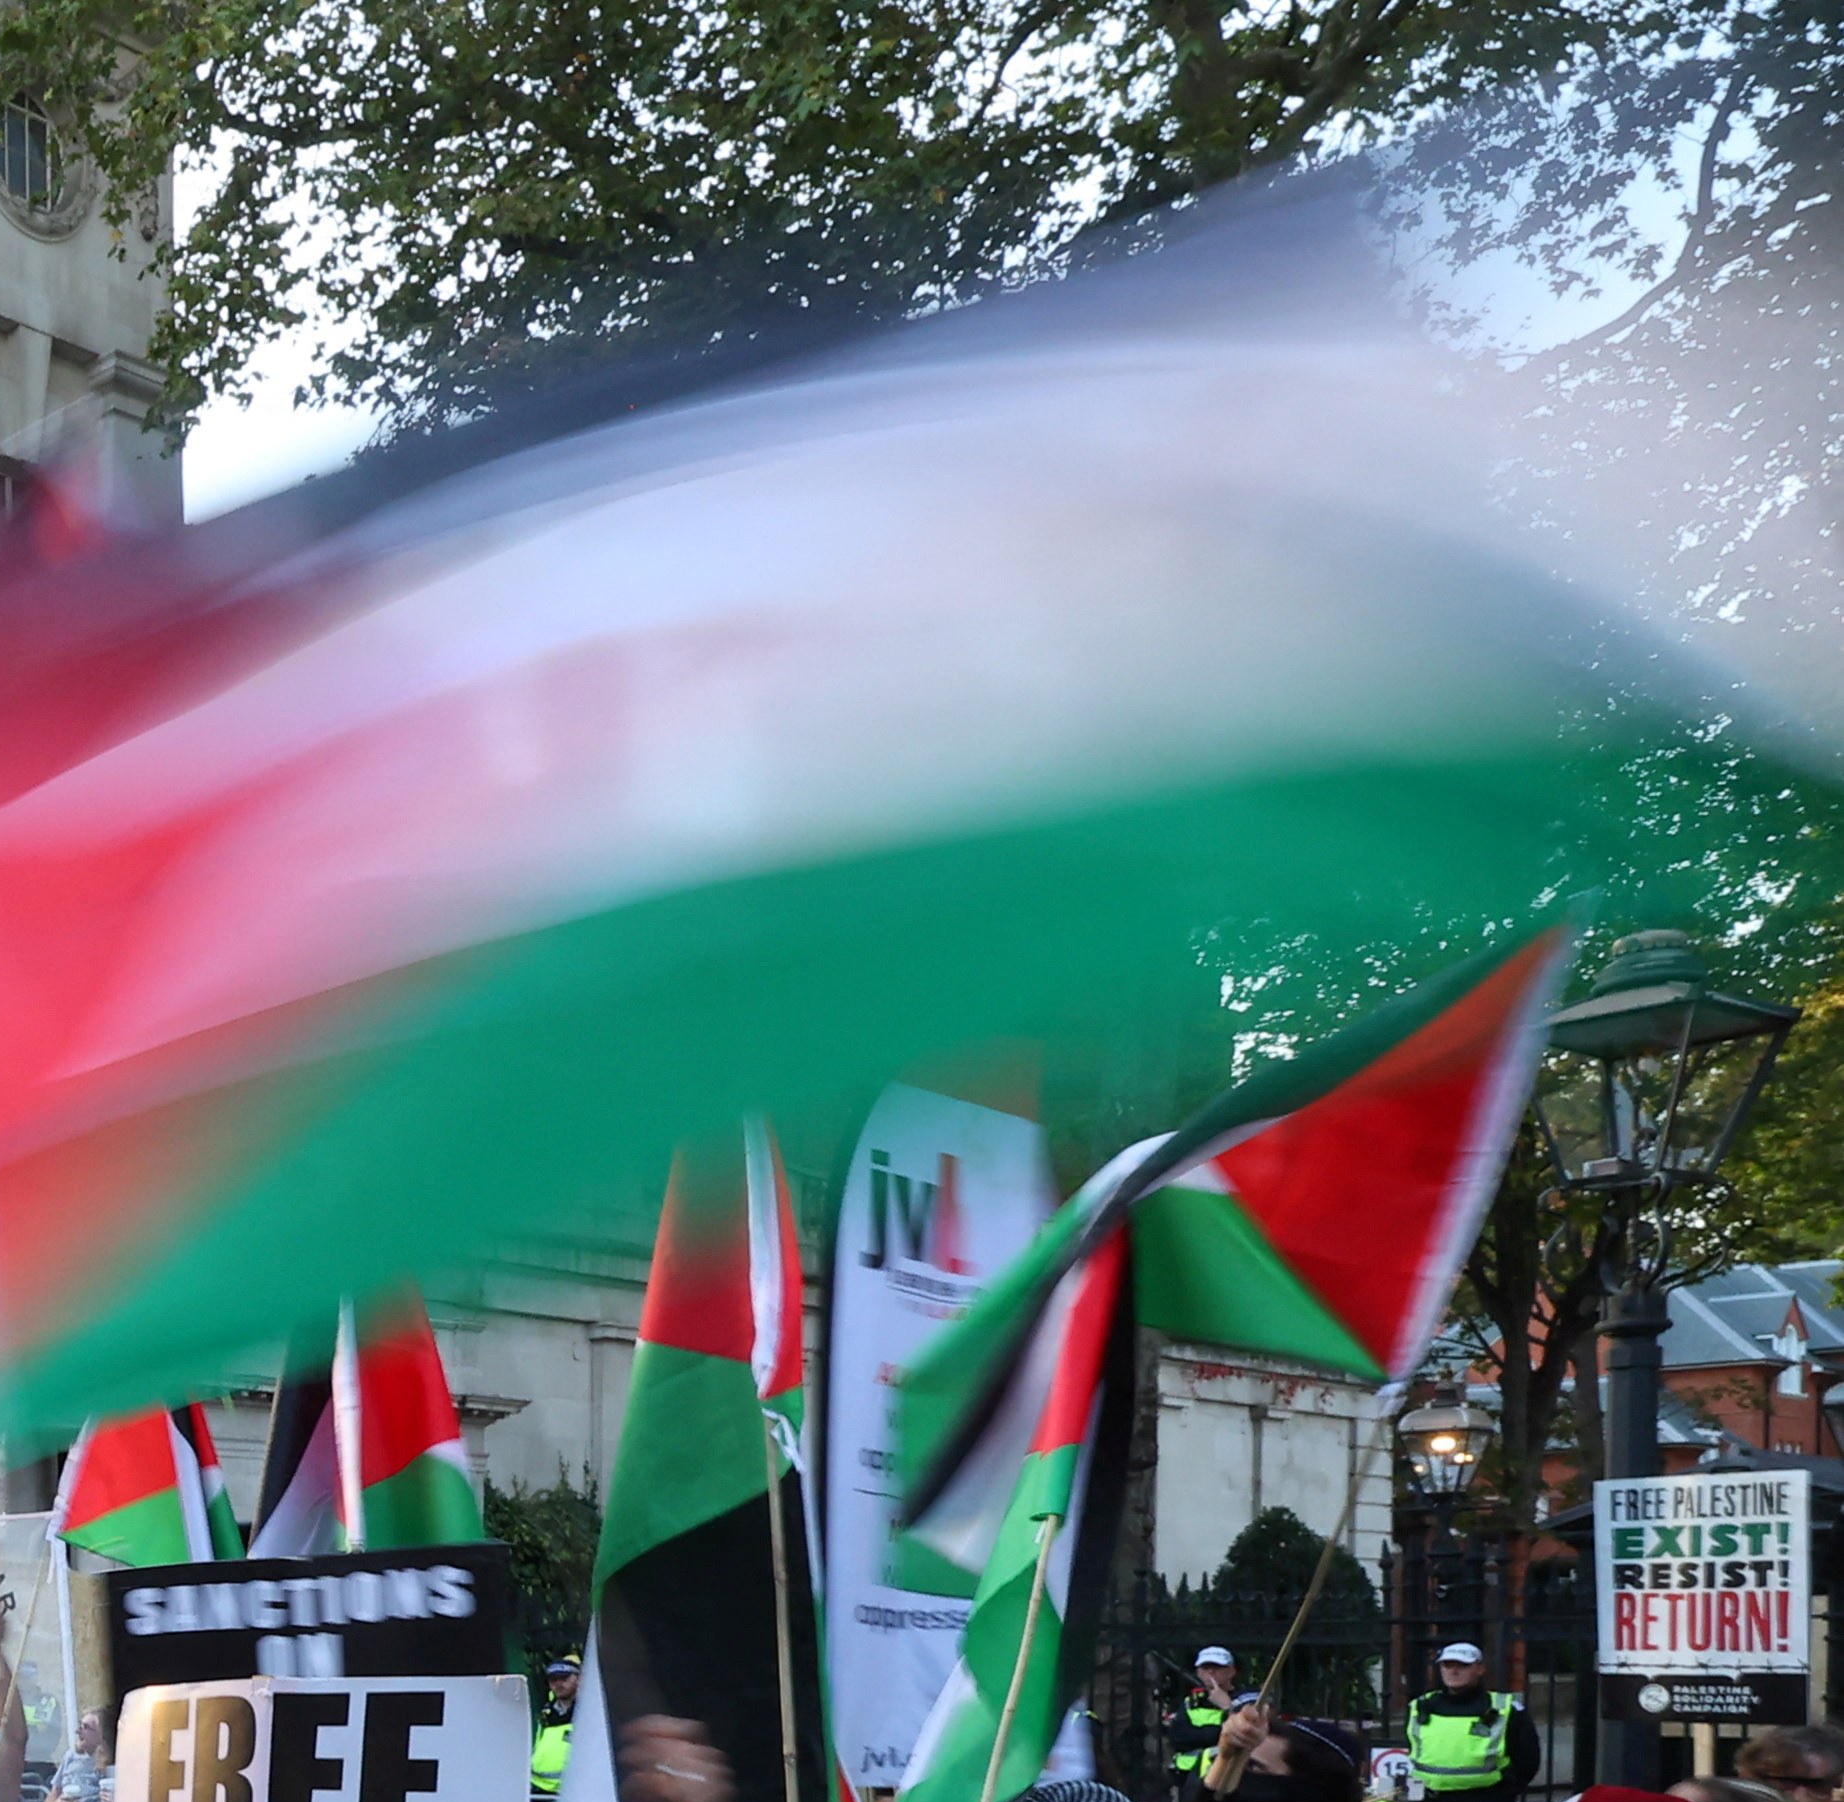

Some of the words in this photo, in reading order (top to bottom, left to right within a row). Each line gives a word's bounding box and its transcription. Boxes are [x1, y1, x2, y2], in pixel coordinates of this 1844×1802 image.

[1610, 1486, 1667, 1522] FREE
[1671, 1480, 1791, 1520] PALESTINE
[1613, 1521, 1790, 1560] EXIST!
[1613, 1560, 1790, 1591] RESIST!
[1614, 1590, 1790, 1653] RETURN!
[1672, 1684, 1752, 1695] PALESTINE
[1672, 1694, 1760, 1705] SOLIDARITY
[1672, 1703, 1749, 1714] CAMPAIGN
[1383, 1761, 1409, 1777] 15
